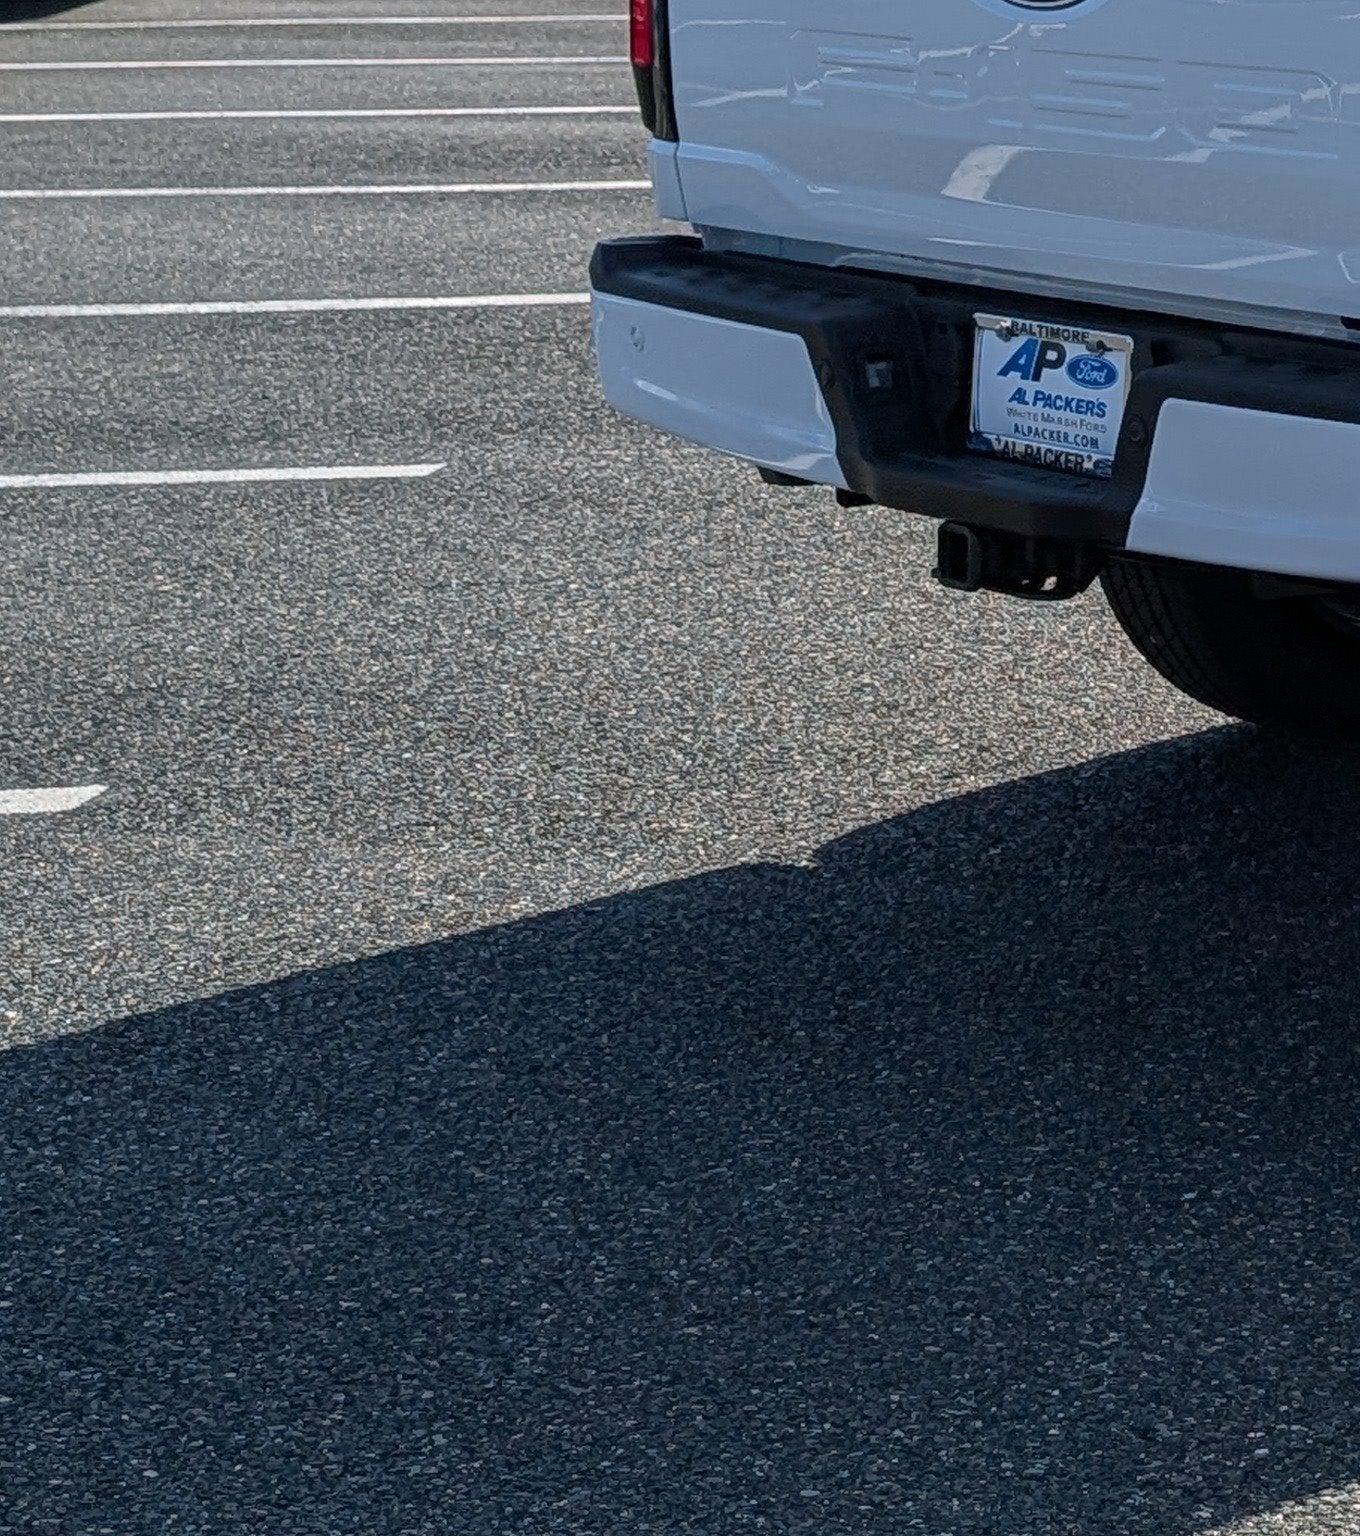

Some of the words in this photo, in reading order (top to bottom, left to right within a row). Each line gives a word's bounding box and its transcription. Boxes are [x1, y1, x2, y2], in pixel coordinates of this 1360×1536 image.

[1010, 320, 1091, 344] BALTIMORE
[997, 337, 1067, 382] AP
[1008, 386, 1029, 406] AL
[1032, 389, 1108, 419] PACKER'S
[1013, 422, 1099, 450] ALPACKER.COM
